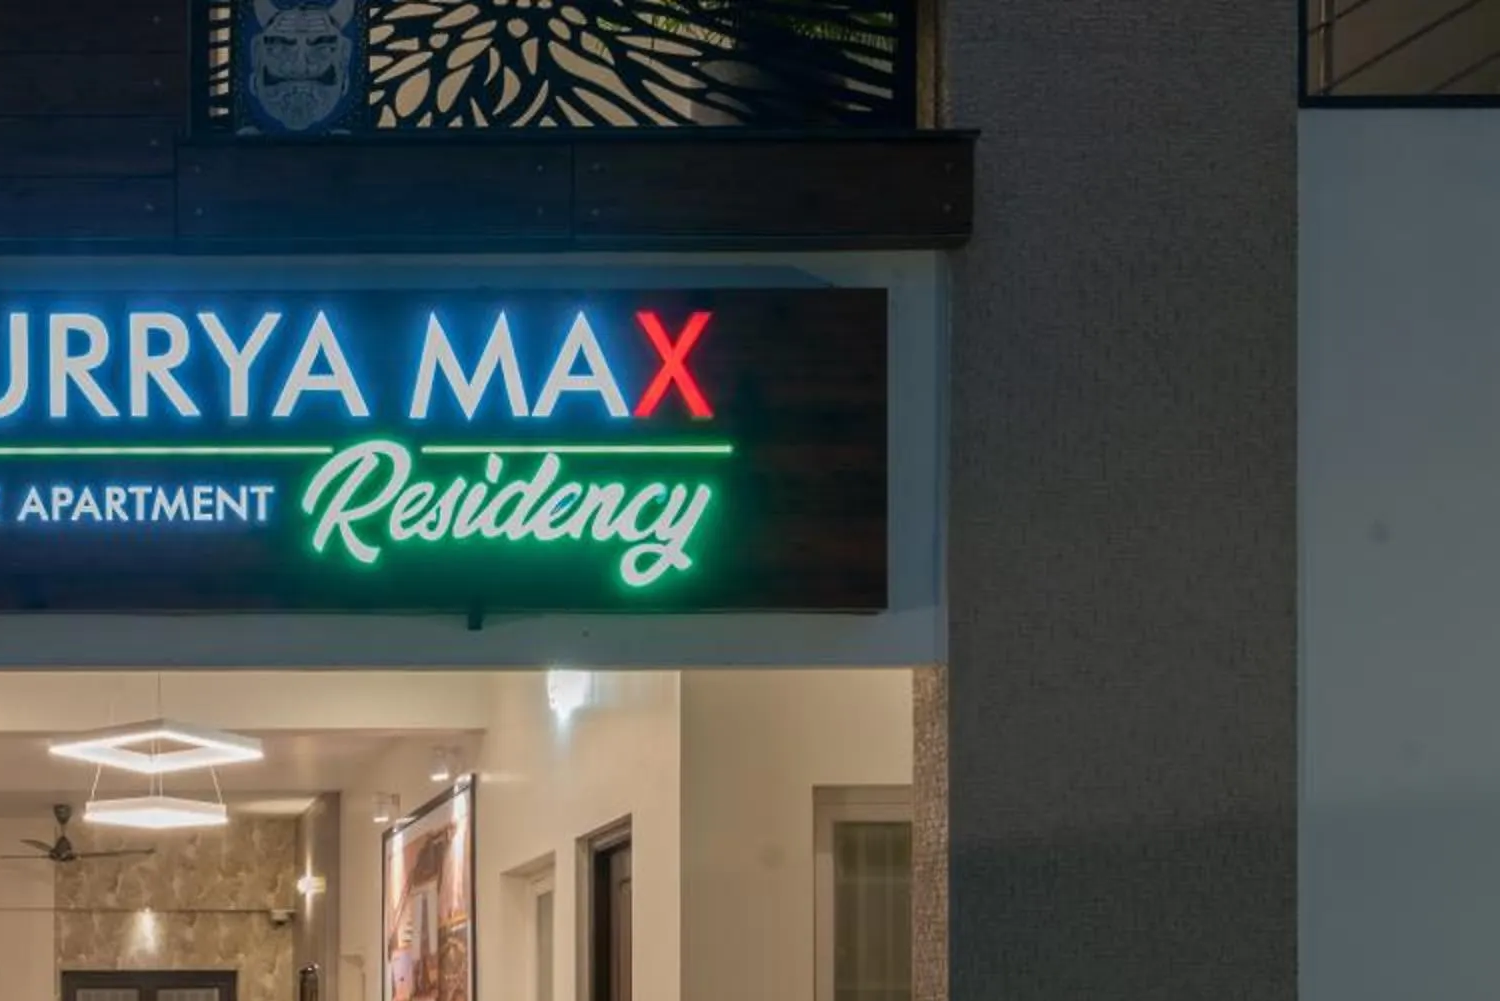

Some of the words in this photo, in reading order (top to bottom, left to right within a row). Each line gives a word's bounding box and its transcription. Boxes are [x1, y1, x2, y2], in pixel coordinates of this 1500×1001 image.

[409, 310, 713, 421] MAX
[16, 485, 275, 522] APARTMENT
[302, 440, 711, 587] Residency
